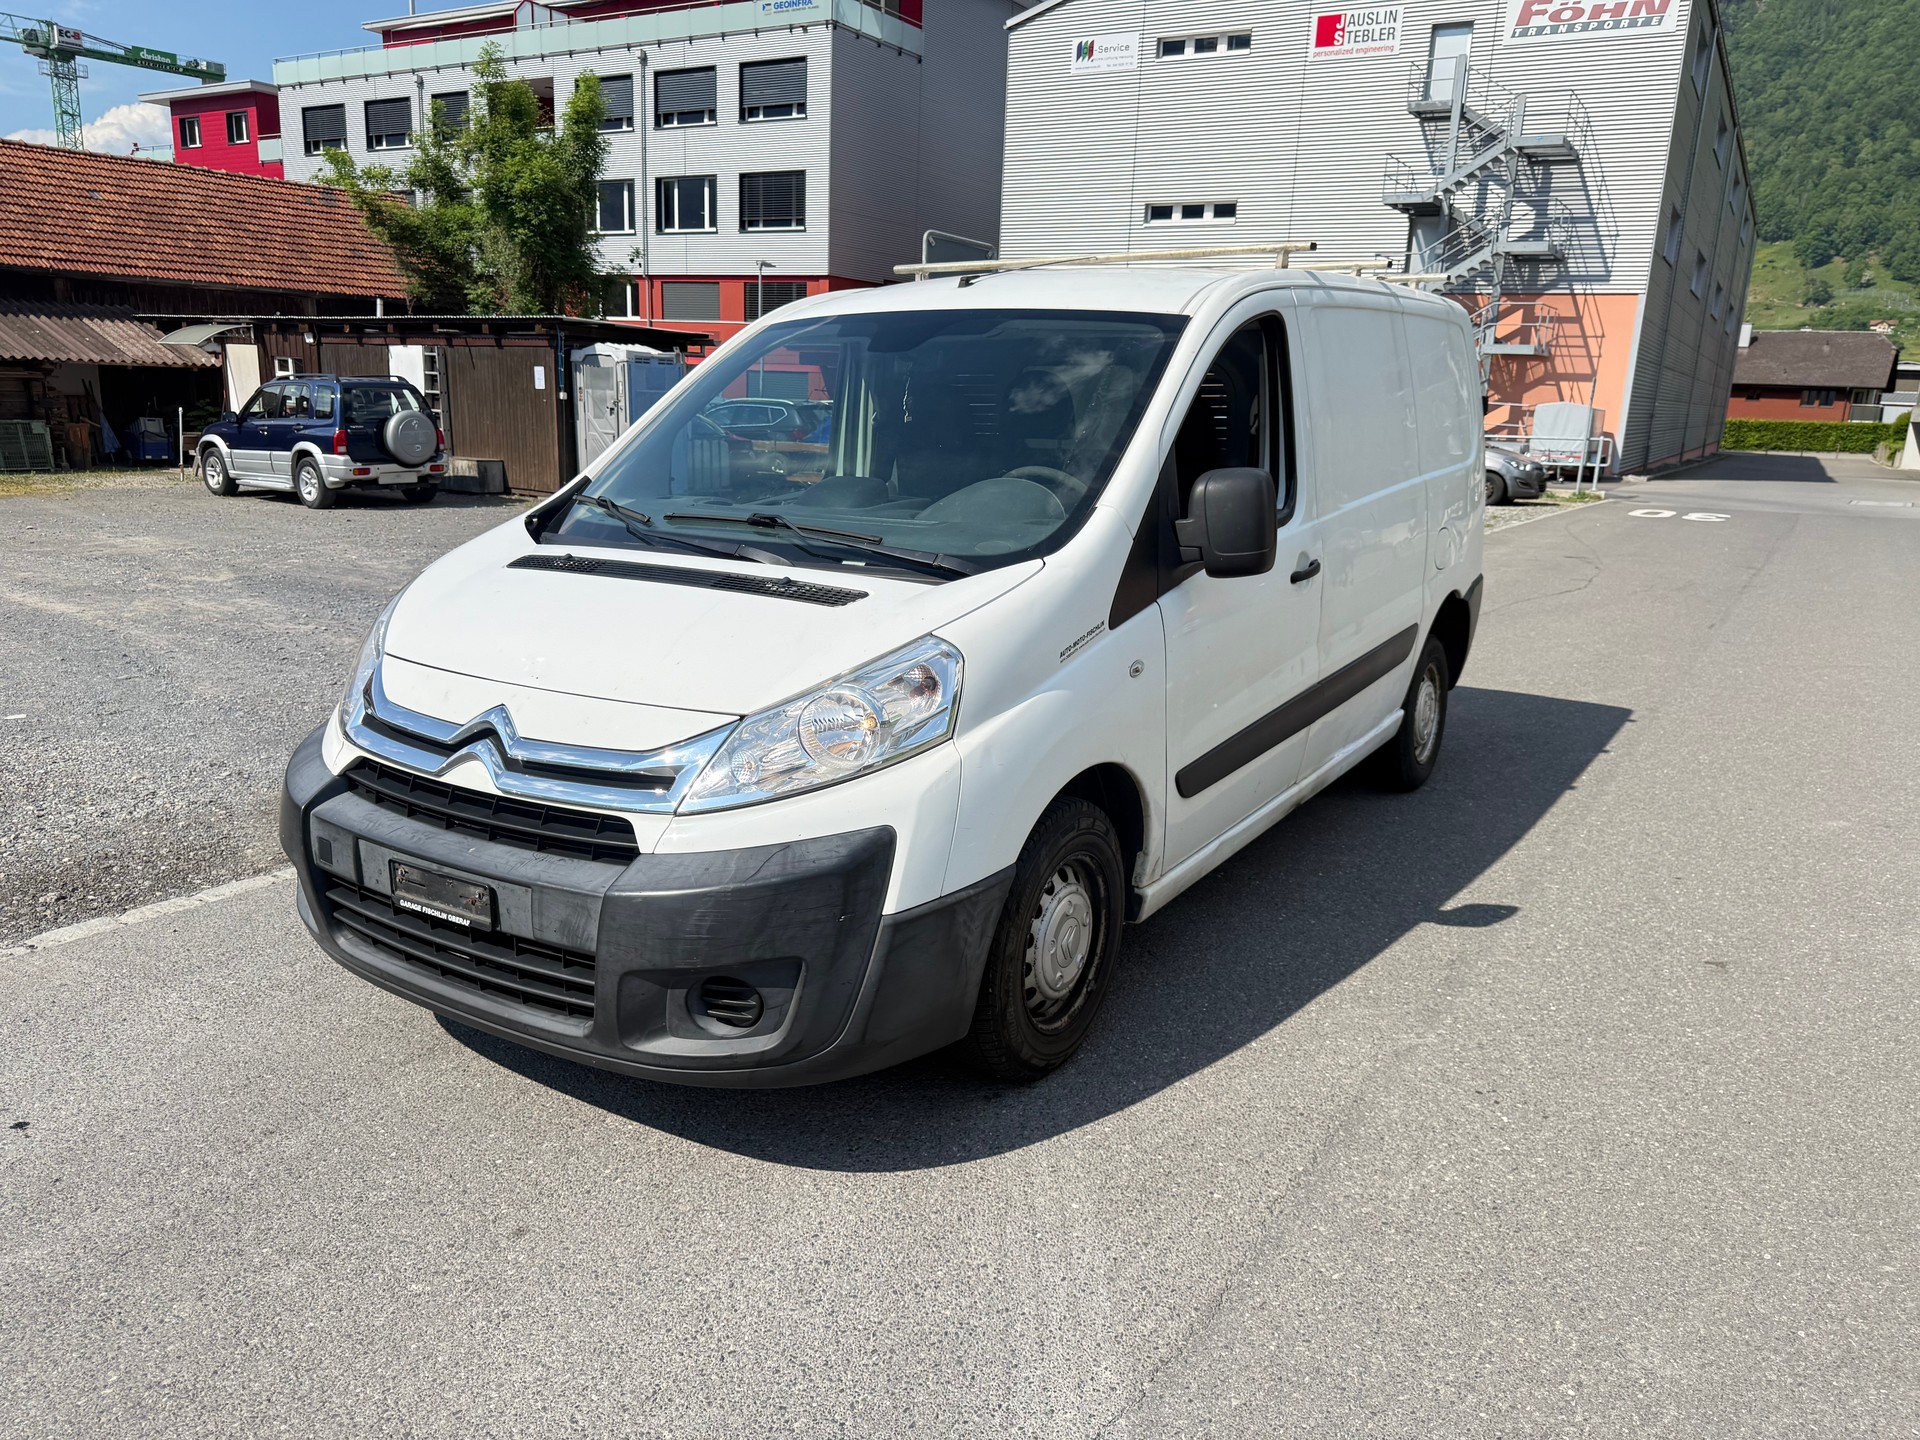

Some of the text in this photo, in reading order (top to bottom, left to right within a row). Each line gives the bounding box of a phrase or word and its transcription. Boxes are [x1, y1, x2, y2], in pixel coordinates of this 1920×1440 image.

[773, 0, 813, 10] GEOINFRA
[1515, 0, 1671, 26] FÖHN
[1514, 16, 1661, 37] TRANSPORTE
[1313, 45, 1395, 59] personalized engineering
[400, 899, 422, 912] GARAGE
